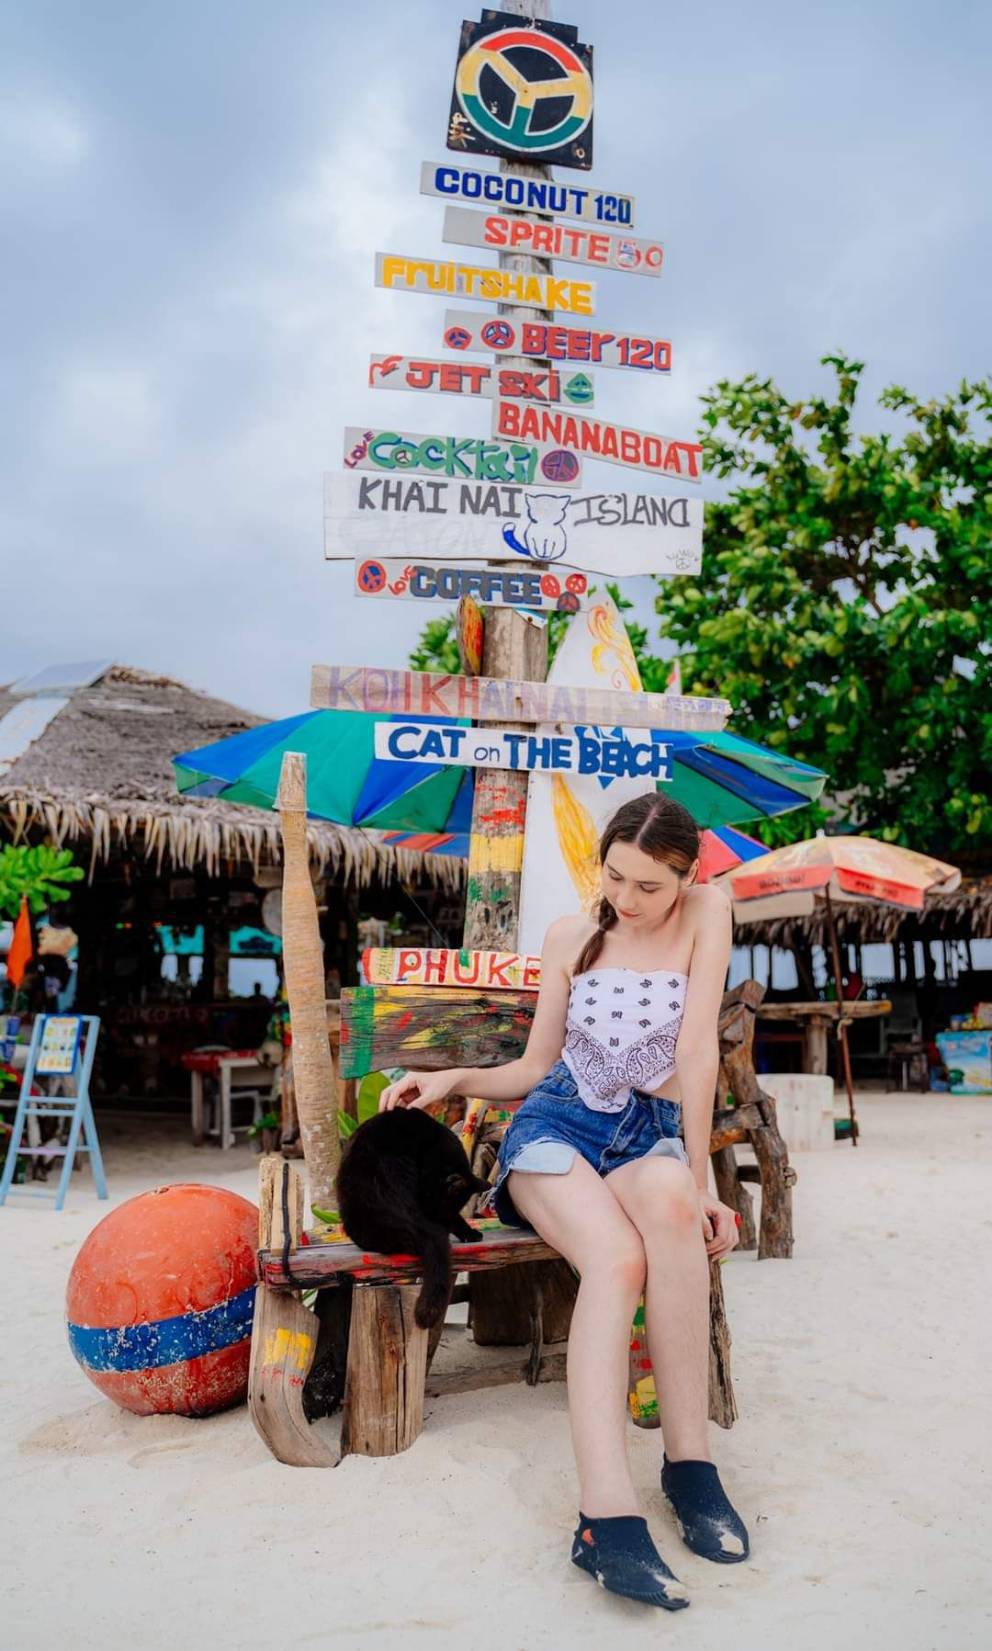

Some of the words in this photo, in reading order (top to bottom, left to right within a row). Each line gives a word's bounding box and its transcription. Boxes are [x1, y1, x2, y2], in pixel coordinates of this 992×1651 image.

[435, 167, 588, 215] COCONUT
[594, 194, 632, 225] 120
[484, 216, 610, 263] SPRITE
[615, 336, 672, 371] 120
[405, 361, 491, 394] JET
[498, 400, 704, 478] BANANABOAT
[358, 476, 449, 515] KHAI
[459, 484, 524, 519] NAI
[571, 493, 692, 528] ISLAND
[409, 566, 543, 606] COFFEE
[388, 725, 466, 759] CAT
[474, 745, 501, 763] on
[502, 733, 572, 769] THE
[577, 737, 674, 780] BEACH
[397, 950, 541, 986] PHUKE
